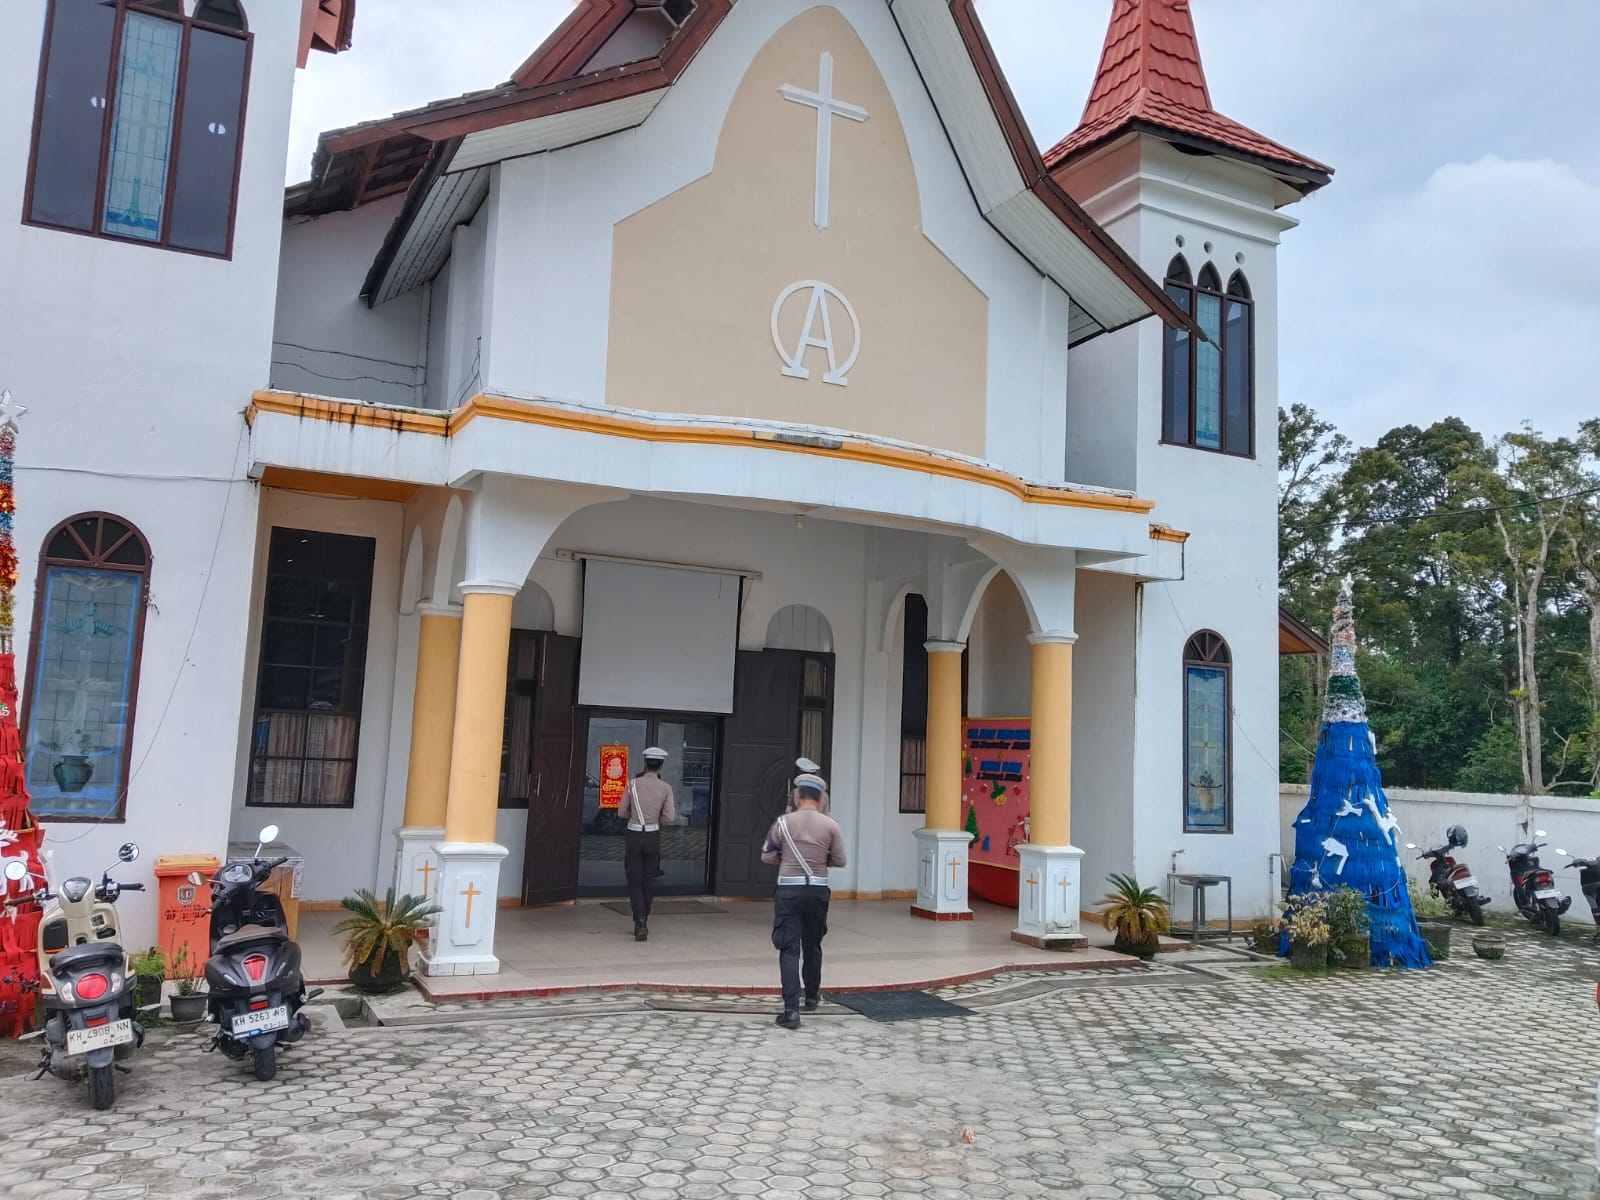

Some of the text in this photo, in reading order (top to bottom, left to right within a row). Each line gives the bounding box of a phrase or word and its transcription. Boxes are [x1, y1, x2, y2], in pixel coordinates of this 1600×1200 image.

[234, 1017, 246, 1027] KH
[249, 1012, 270, 1023] 5263
[69, 1020, 129, 1042] KH 4908 NN
